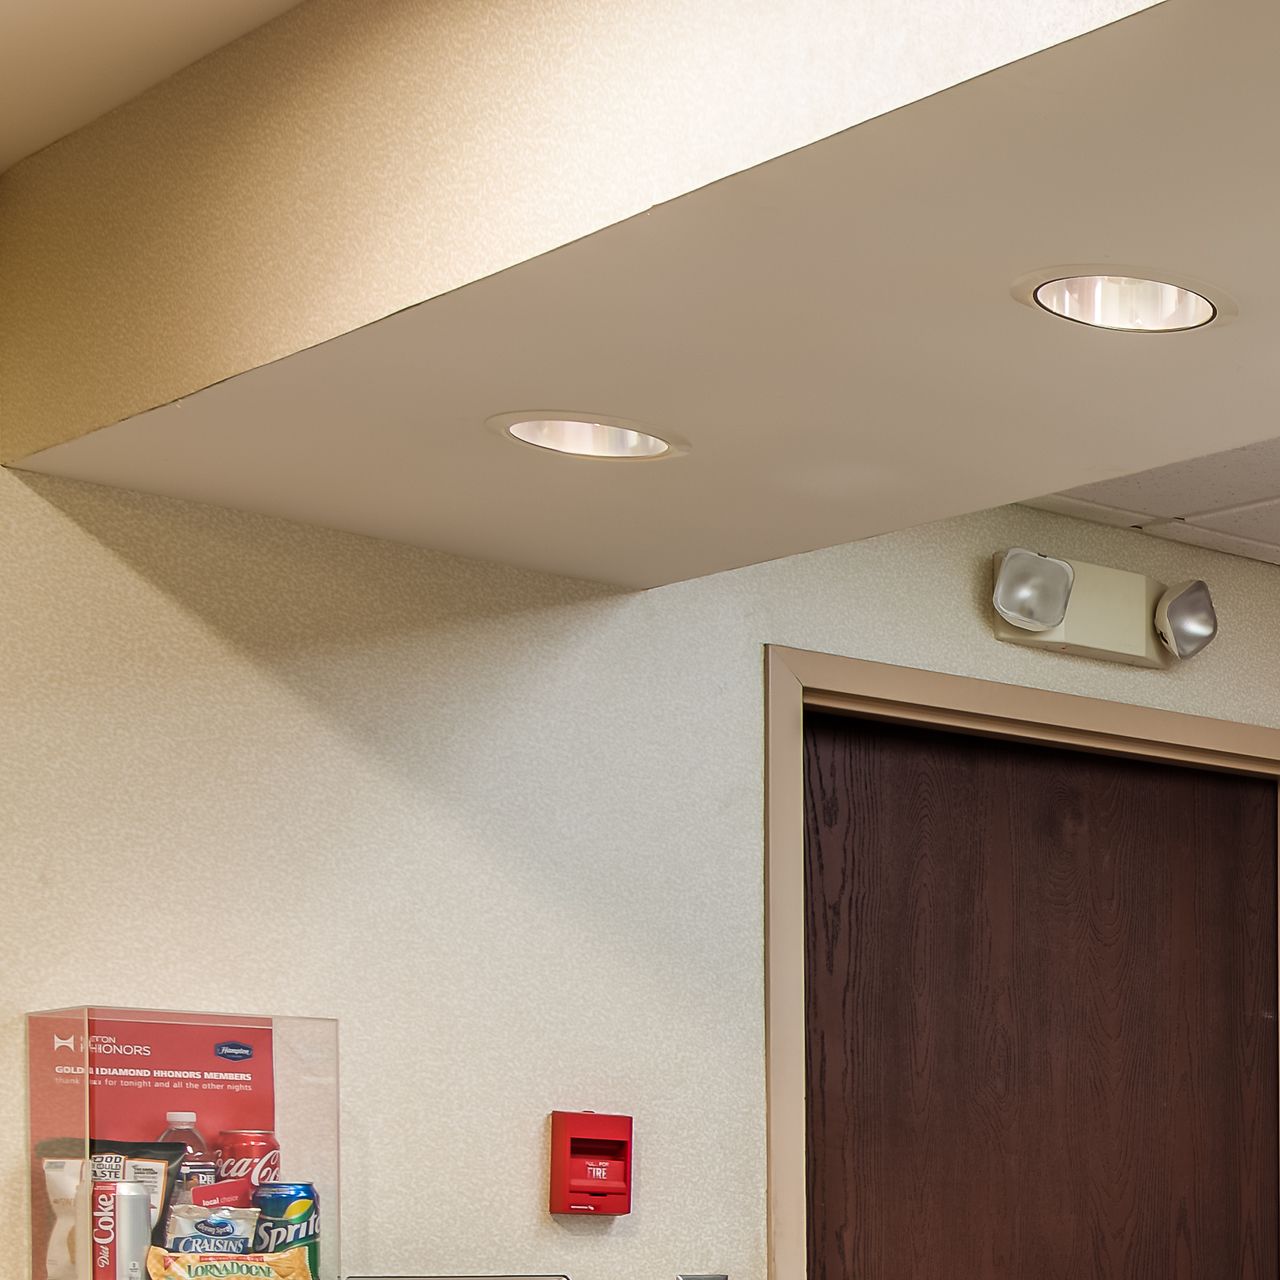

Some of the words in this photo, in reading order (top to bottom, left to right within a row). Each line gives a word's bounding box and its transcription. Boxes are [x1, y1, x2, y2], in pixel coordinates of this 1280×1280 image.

[55, 1066, 85, 1074] GOLD
[153, 1069, 202, 1079] HHONORS
[204, 1071, 252, 1081] MEMBERS
[105, 1078, 117, 1086] for
[120, 1078, 151, 1090] tonight
[154, 1080, 170, 1088] and
[172, 1081, 183, 1089] all
[185, 1081, 199, 1089] the
[202, 1082, 224, 1090] other
[227, 1082, 252, 1093] nights
[587, 1167, 607, 1179] FIRE
[202, 1196, 220, 1206] local
[93, 1193, 116, 1244] Coke
[178, 1237, 245, 1253] CRAISINS
